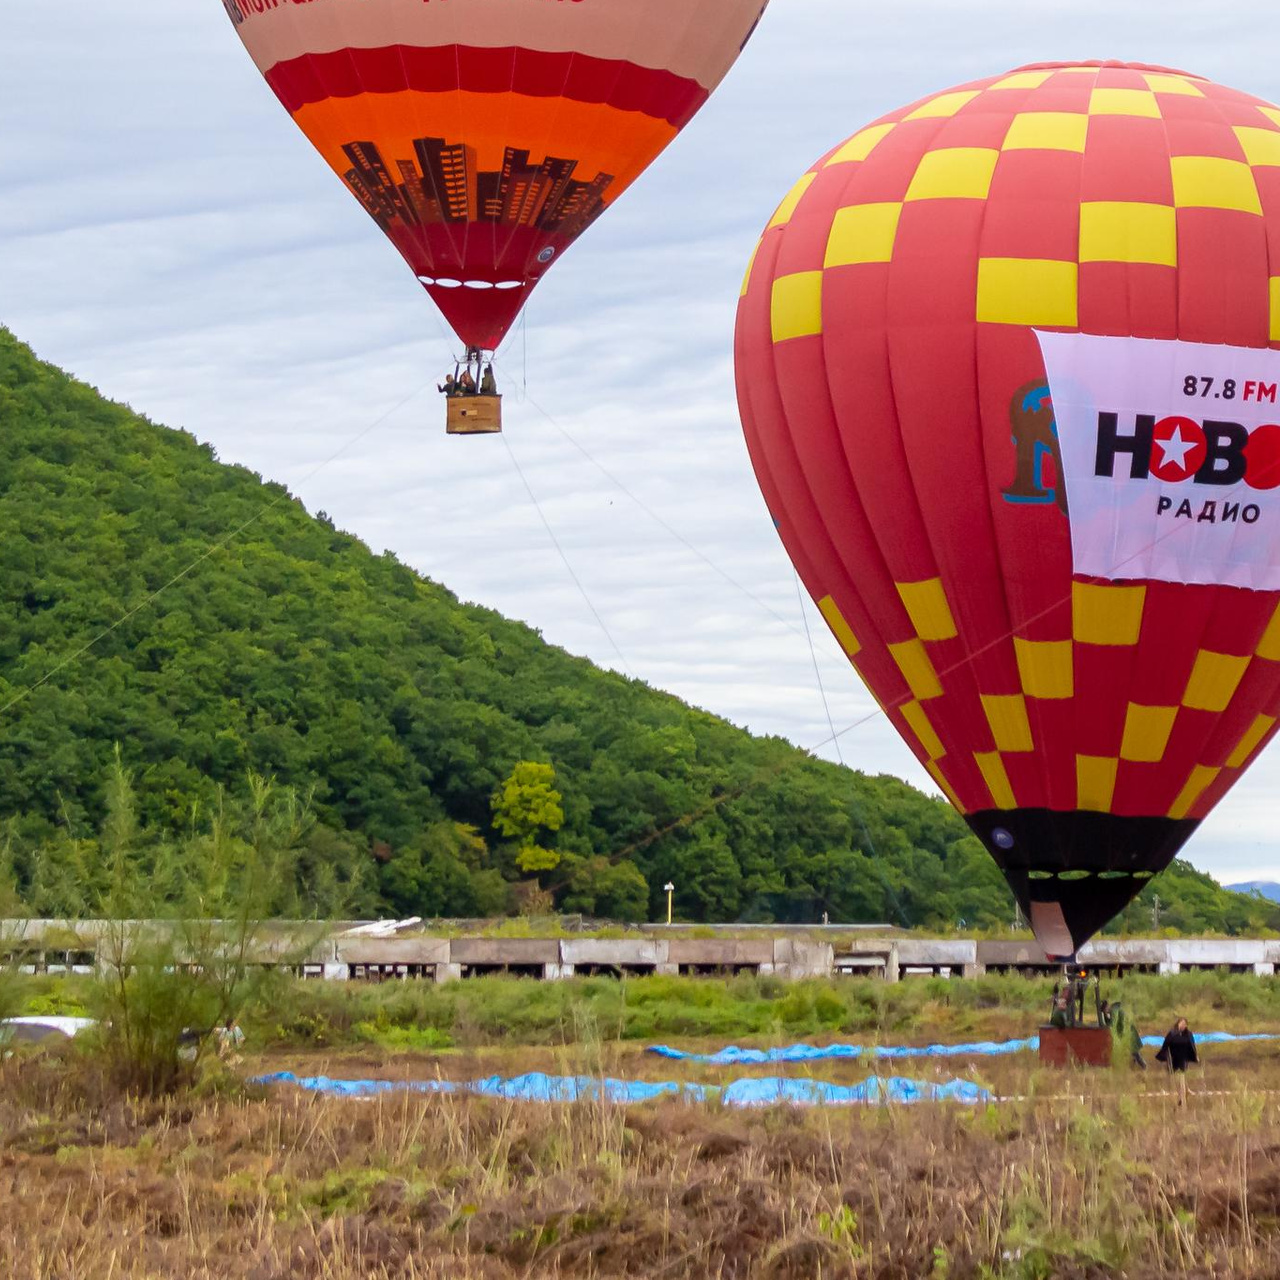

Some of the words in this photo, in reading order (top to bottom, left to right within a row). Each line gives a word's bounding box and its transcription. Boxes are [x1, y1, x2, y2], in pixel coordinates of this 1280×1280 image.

[1183, 375, 1236, 400] 87.8
[1243, 380, 1278, 403] FM
[1157, 495, 1261, 524] РАДИО
